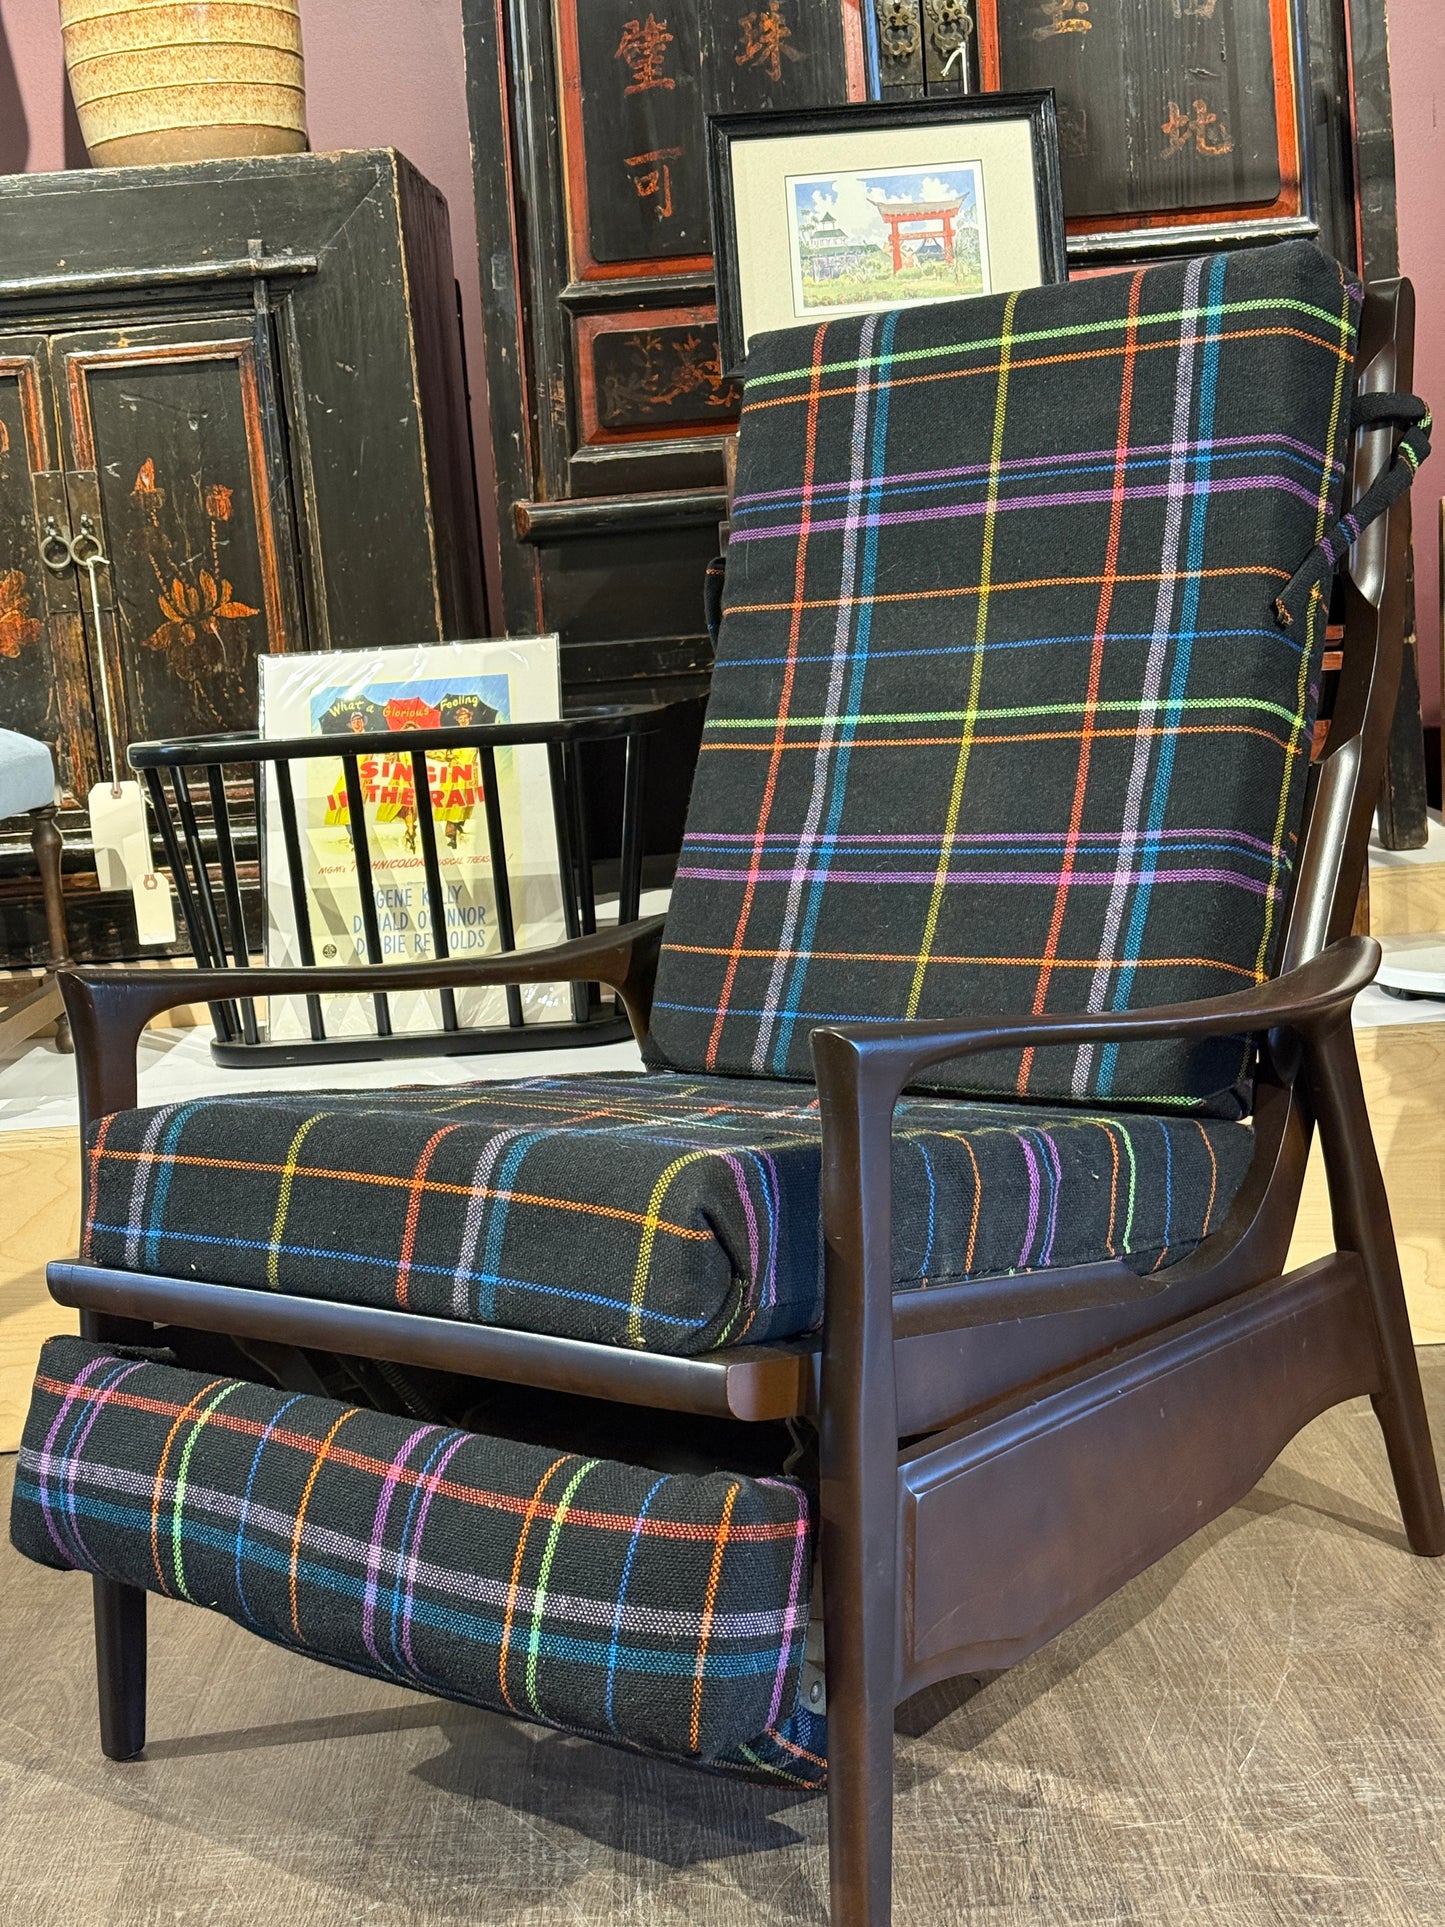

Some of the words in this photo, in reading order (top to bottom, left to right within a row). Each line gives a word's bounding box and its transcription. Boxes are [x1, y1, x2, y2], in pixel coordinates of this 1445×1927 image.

[329, 700, 364, 718] What
[366, 705, 375, 714] a
[383, 705, 430, 718] Glorious
[440, 695, 479, 712] Feeling
[366, 785, 415, 806] THE
[351, 857, 426, 873] THNICOLOR
[377, 888, 413, 909] GENE
[422, 885, 463, 907] KLY
[353, 911, 409, 934] DALD
[418, 906, 486, 930] O'NNOR
[357, 934, 406, 956] DBIE
[414, 929, 485, 953] REOLDS
